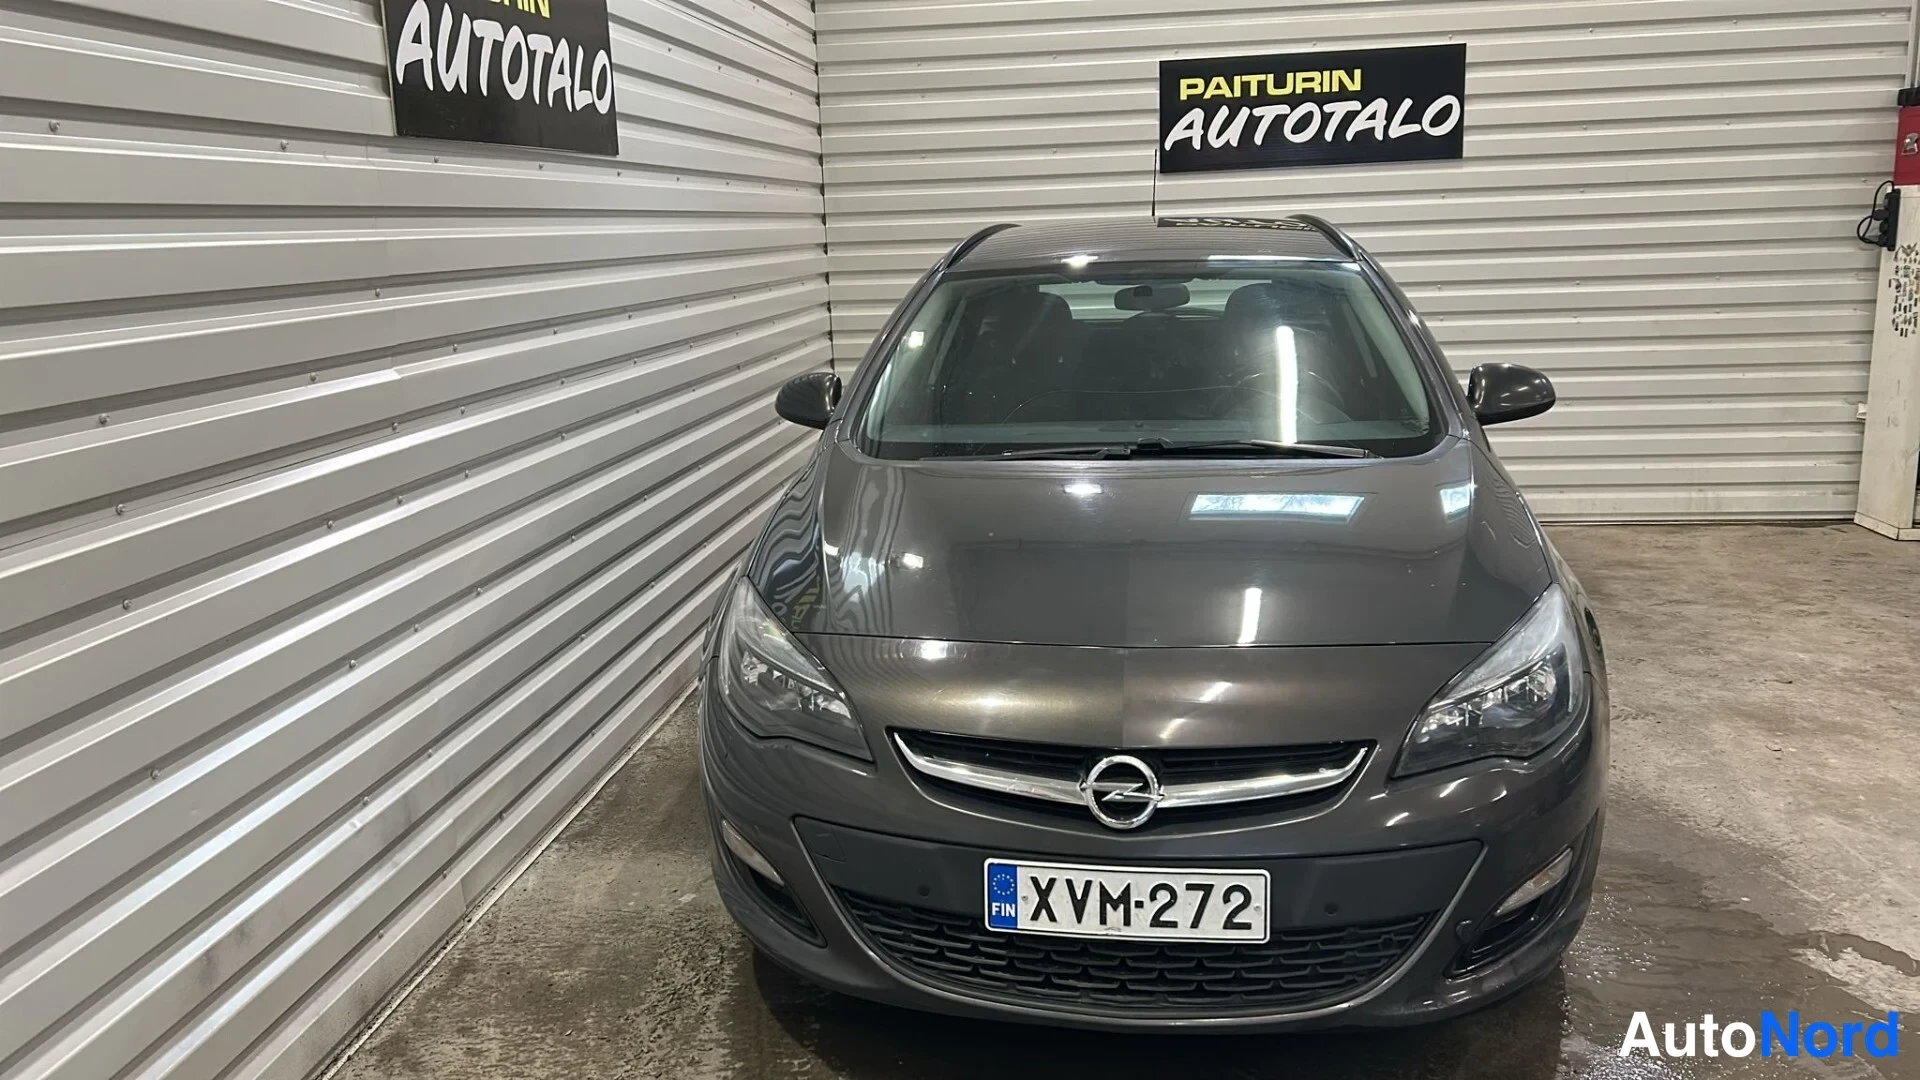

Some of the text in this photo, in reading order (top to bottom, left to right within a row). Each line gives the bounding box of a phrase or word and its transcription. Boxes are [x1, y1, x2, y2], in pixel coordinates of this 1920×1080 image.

[396, 0, 612, 114] AUTOTALO
[1179, 69, 1362, 100] PAITURIN
[1164, 94, 1461, 151] AUTOTALO
[991, 902, 1016, 917] FIN
[1029, 876, 1252, 930] XVM-272
